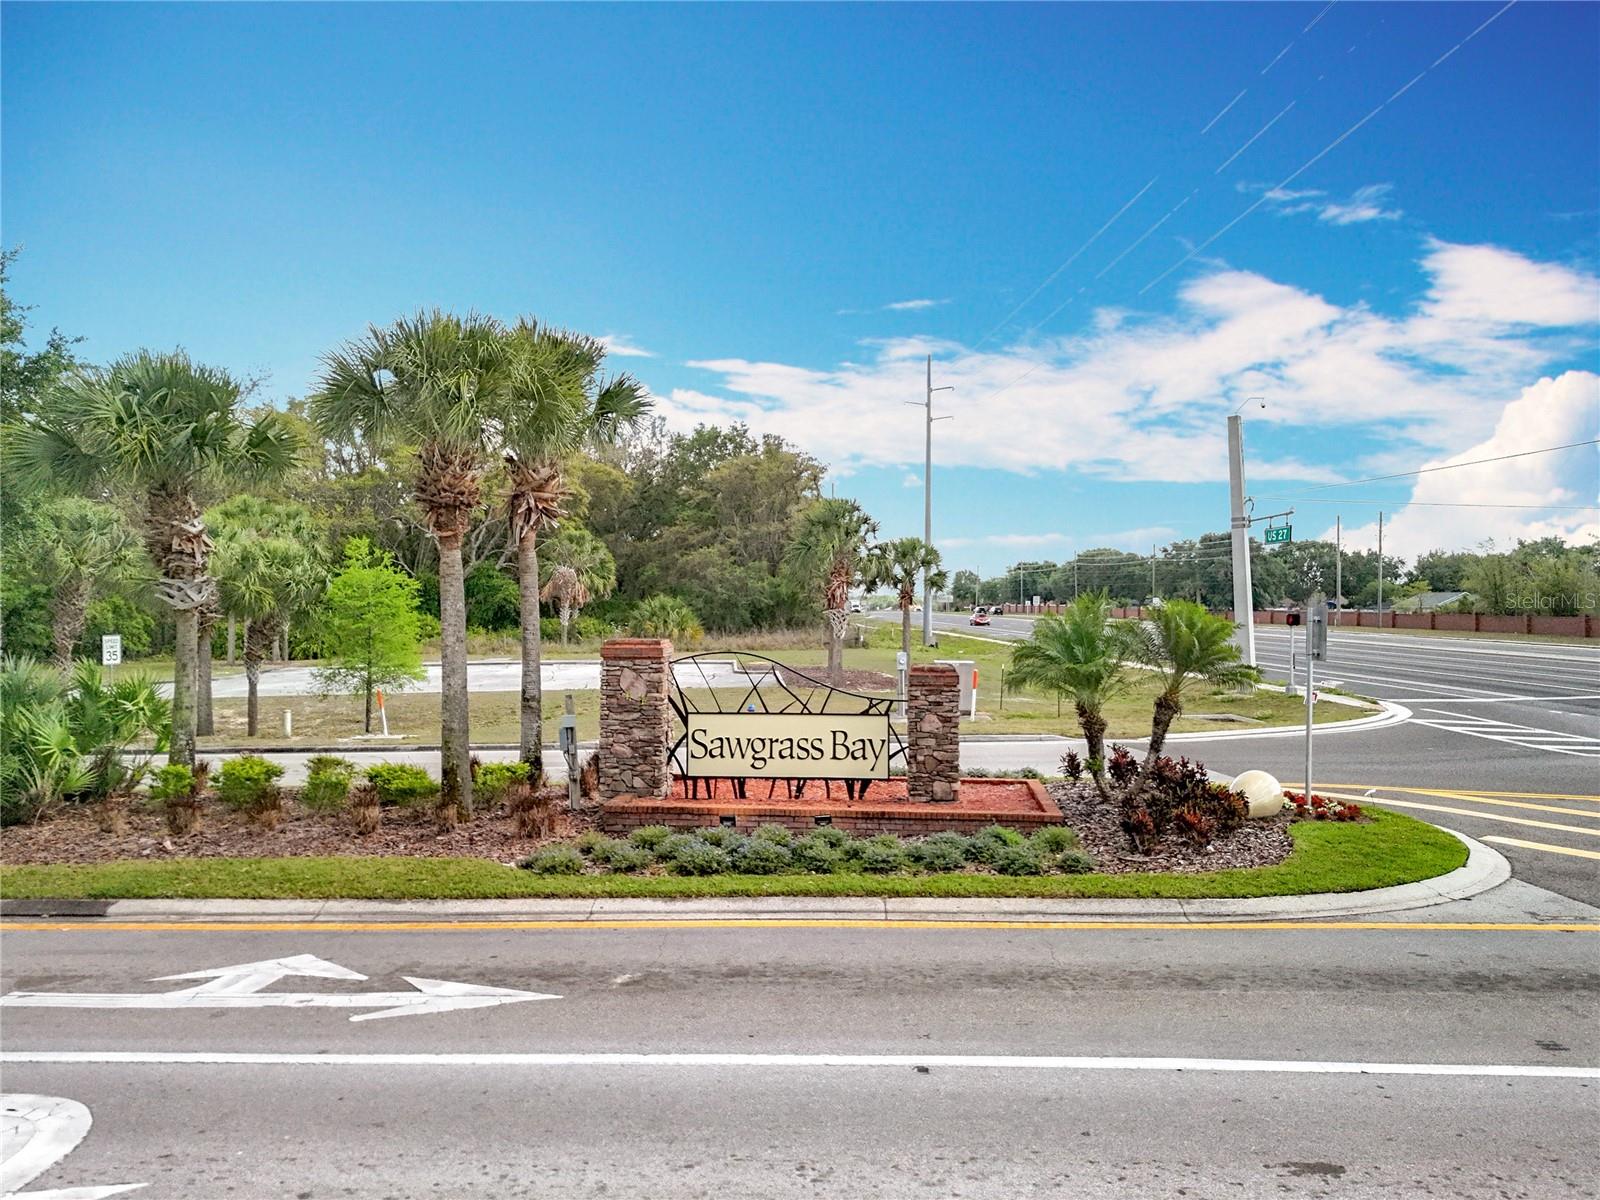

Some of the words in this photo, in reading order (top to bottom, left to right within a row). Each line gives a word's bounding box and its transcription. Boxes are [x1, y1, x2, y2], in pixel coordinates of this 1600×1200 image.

[1267, 531, 1277, 541] US
[1278, 529, 1287, 540] 27
[106, 650, 118, 661] 35
[690, 728, 825, 770] Sawgrass
[830, 729, 886, 771] Bay
